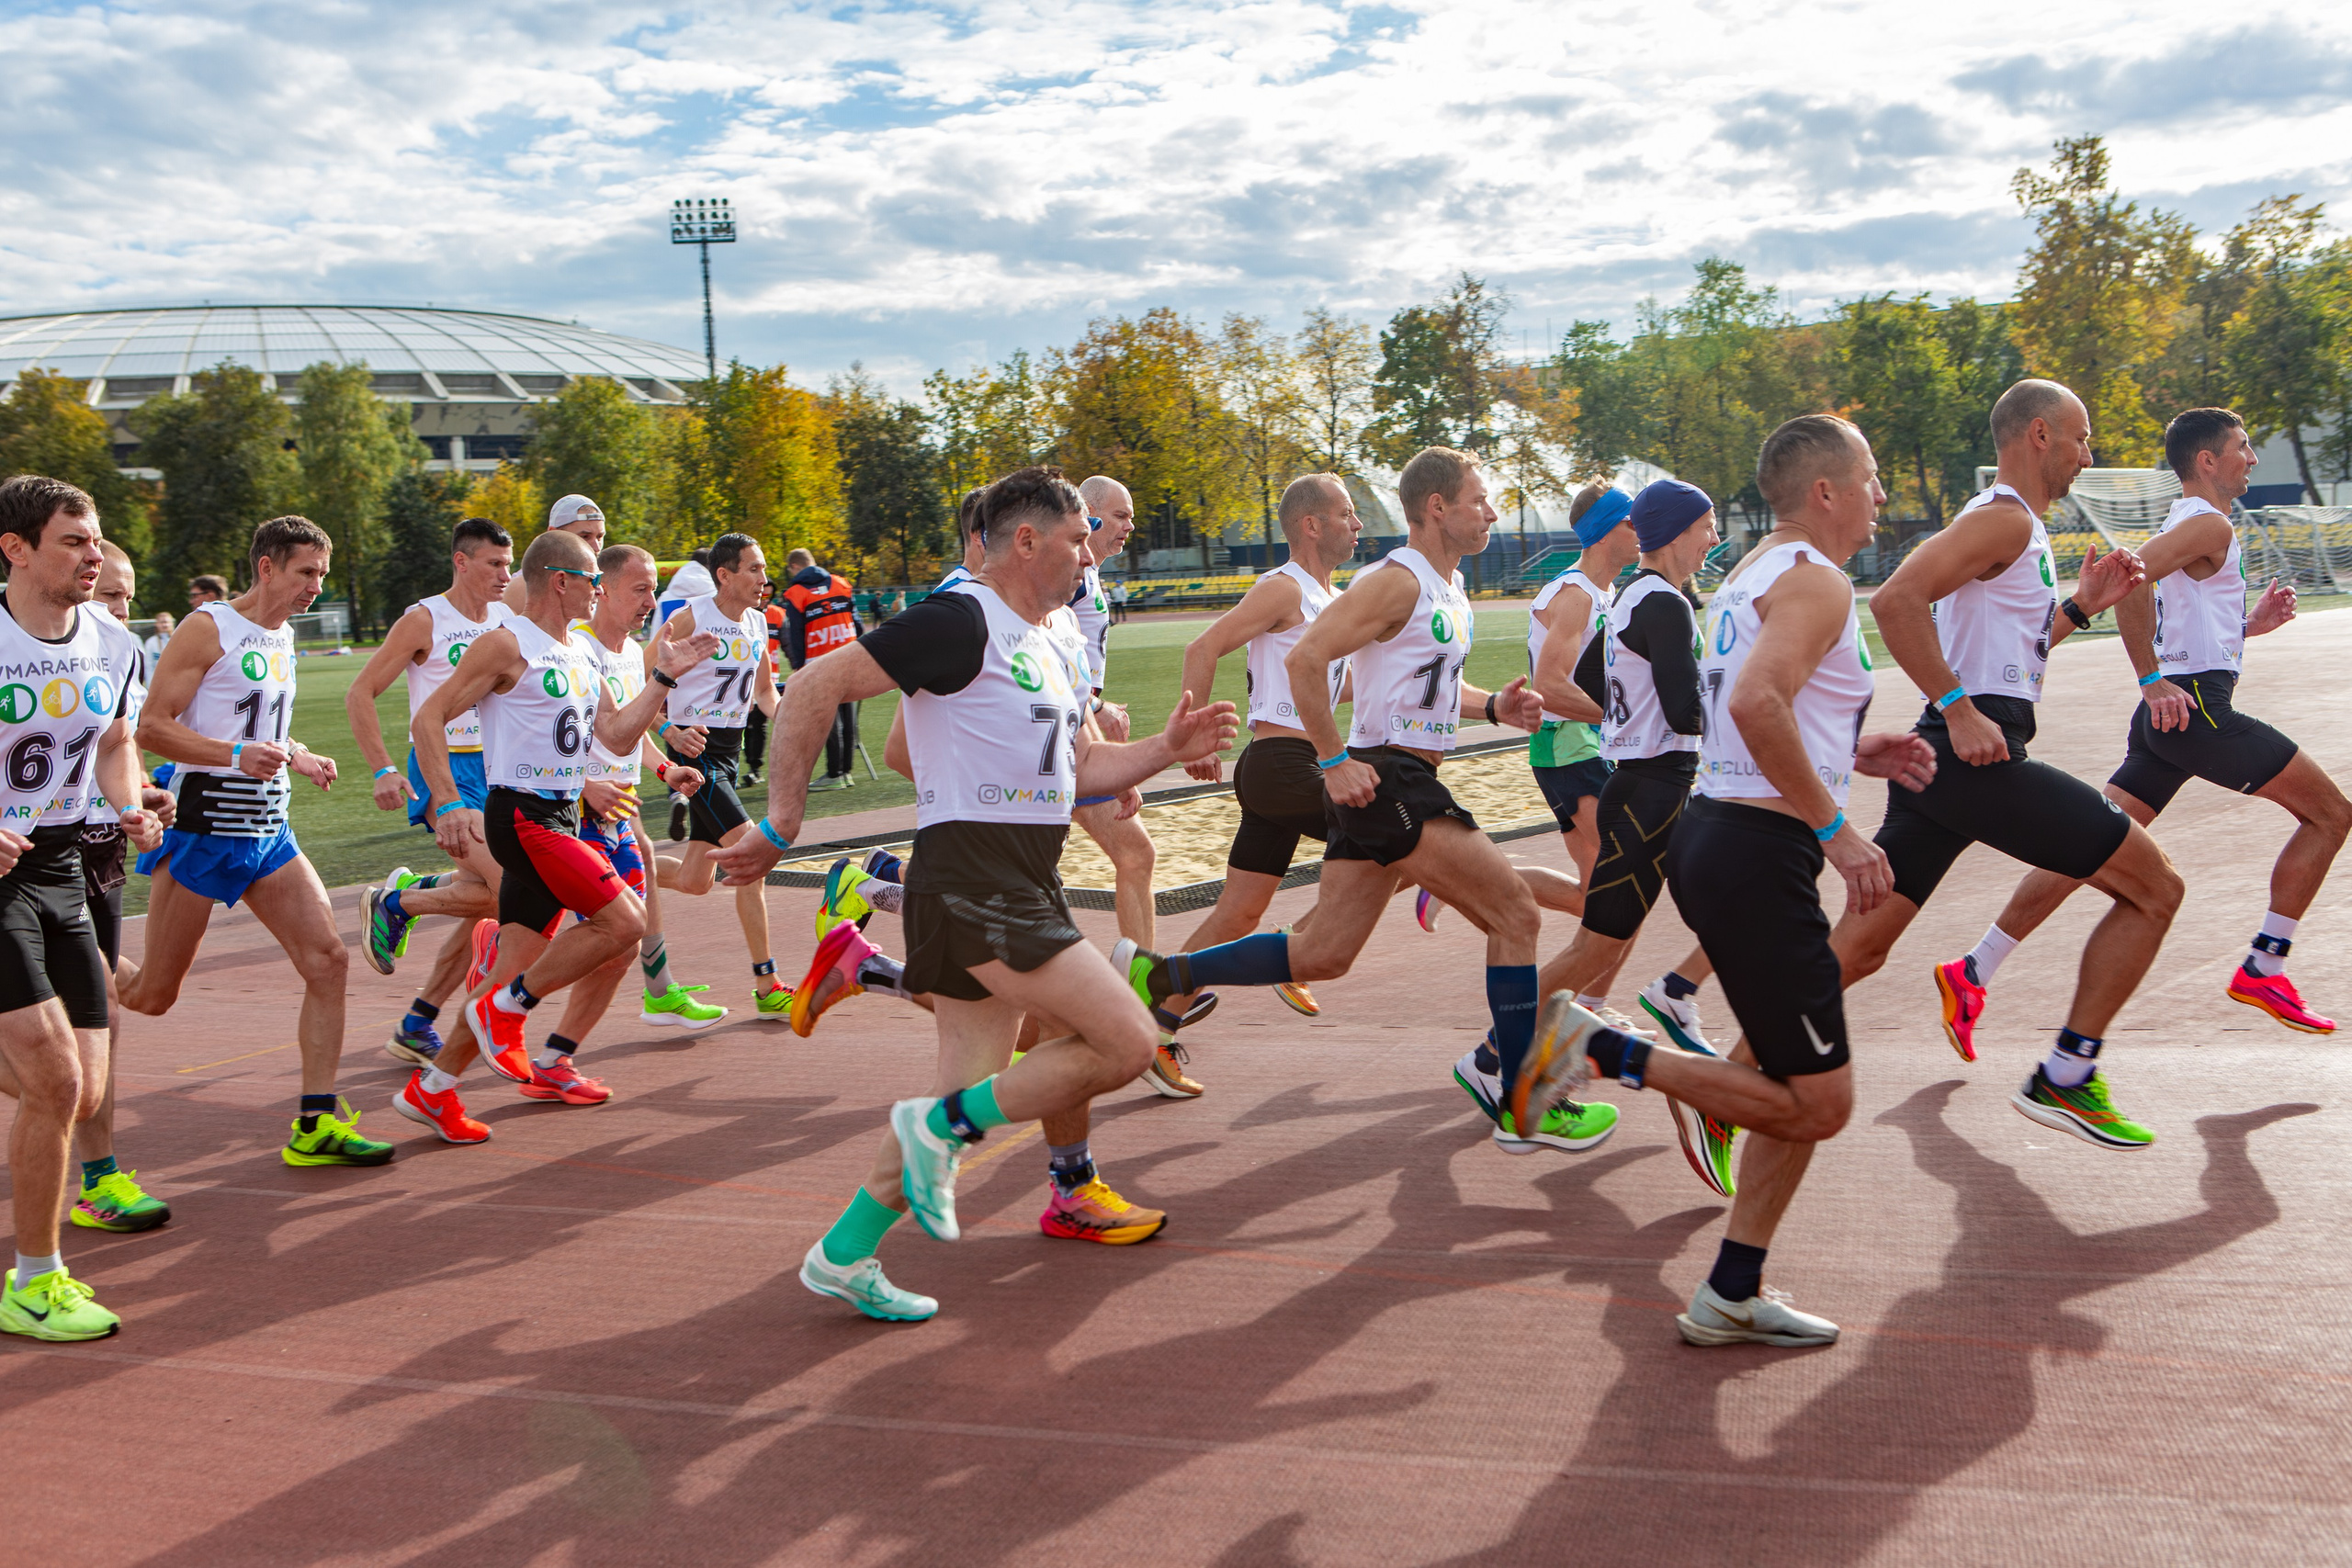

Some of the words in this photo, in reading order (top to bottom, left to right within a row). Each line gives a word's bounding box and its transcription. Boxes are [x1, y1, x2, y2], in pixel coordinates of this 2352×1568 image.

[0, 657, 109, 680] MARAFONE
[713, 667, 754, 705] 70
[234, 690, 295, 742] 11
[6, 727, 98, 793] 61
